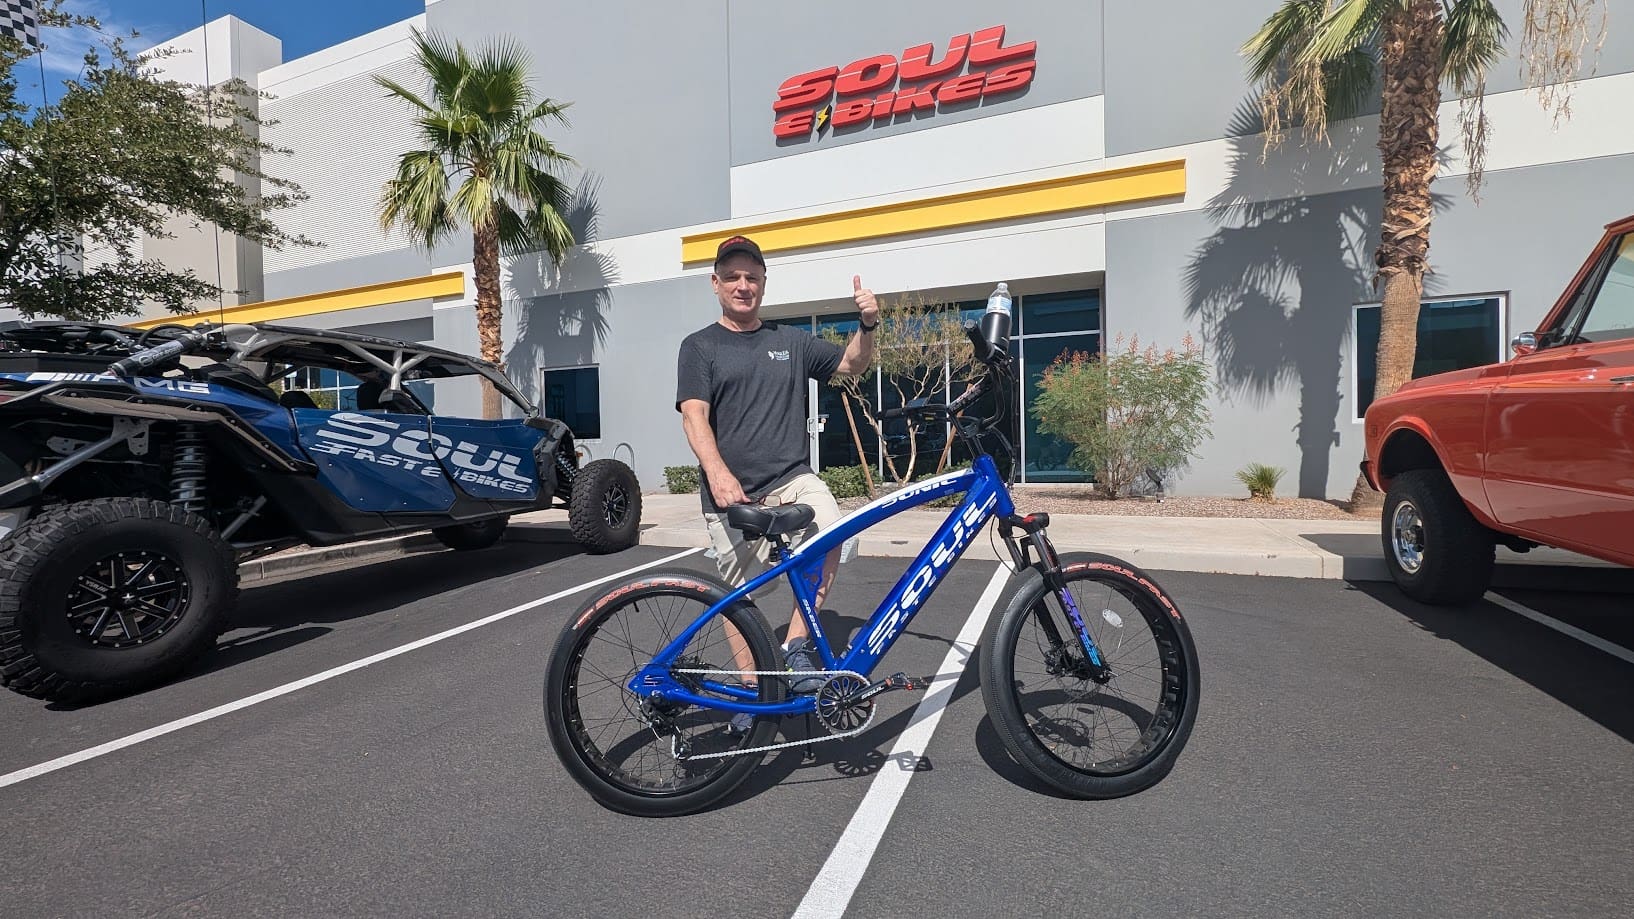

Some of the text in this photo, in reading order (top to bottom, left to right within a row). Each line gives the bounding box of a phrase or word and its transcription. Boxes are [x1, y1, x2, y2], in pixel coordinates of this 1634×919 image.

[772, 60, 1037, 139] E BIKES
[773, 24, 1037, 112] SOUL
[309, 441, 424, 471] FAST
[459, 471, 530, 493] BIKES
[316, 412, 533, 484] SOUL
[867, 491, 997, 656] SOUL
